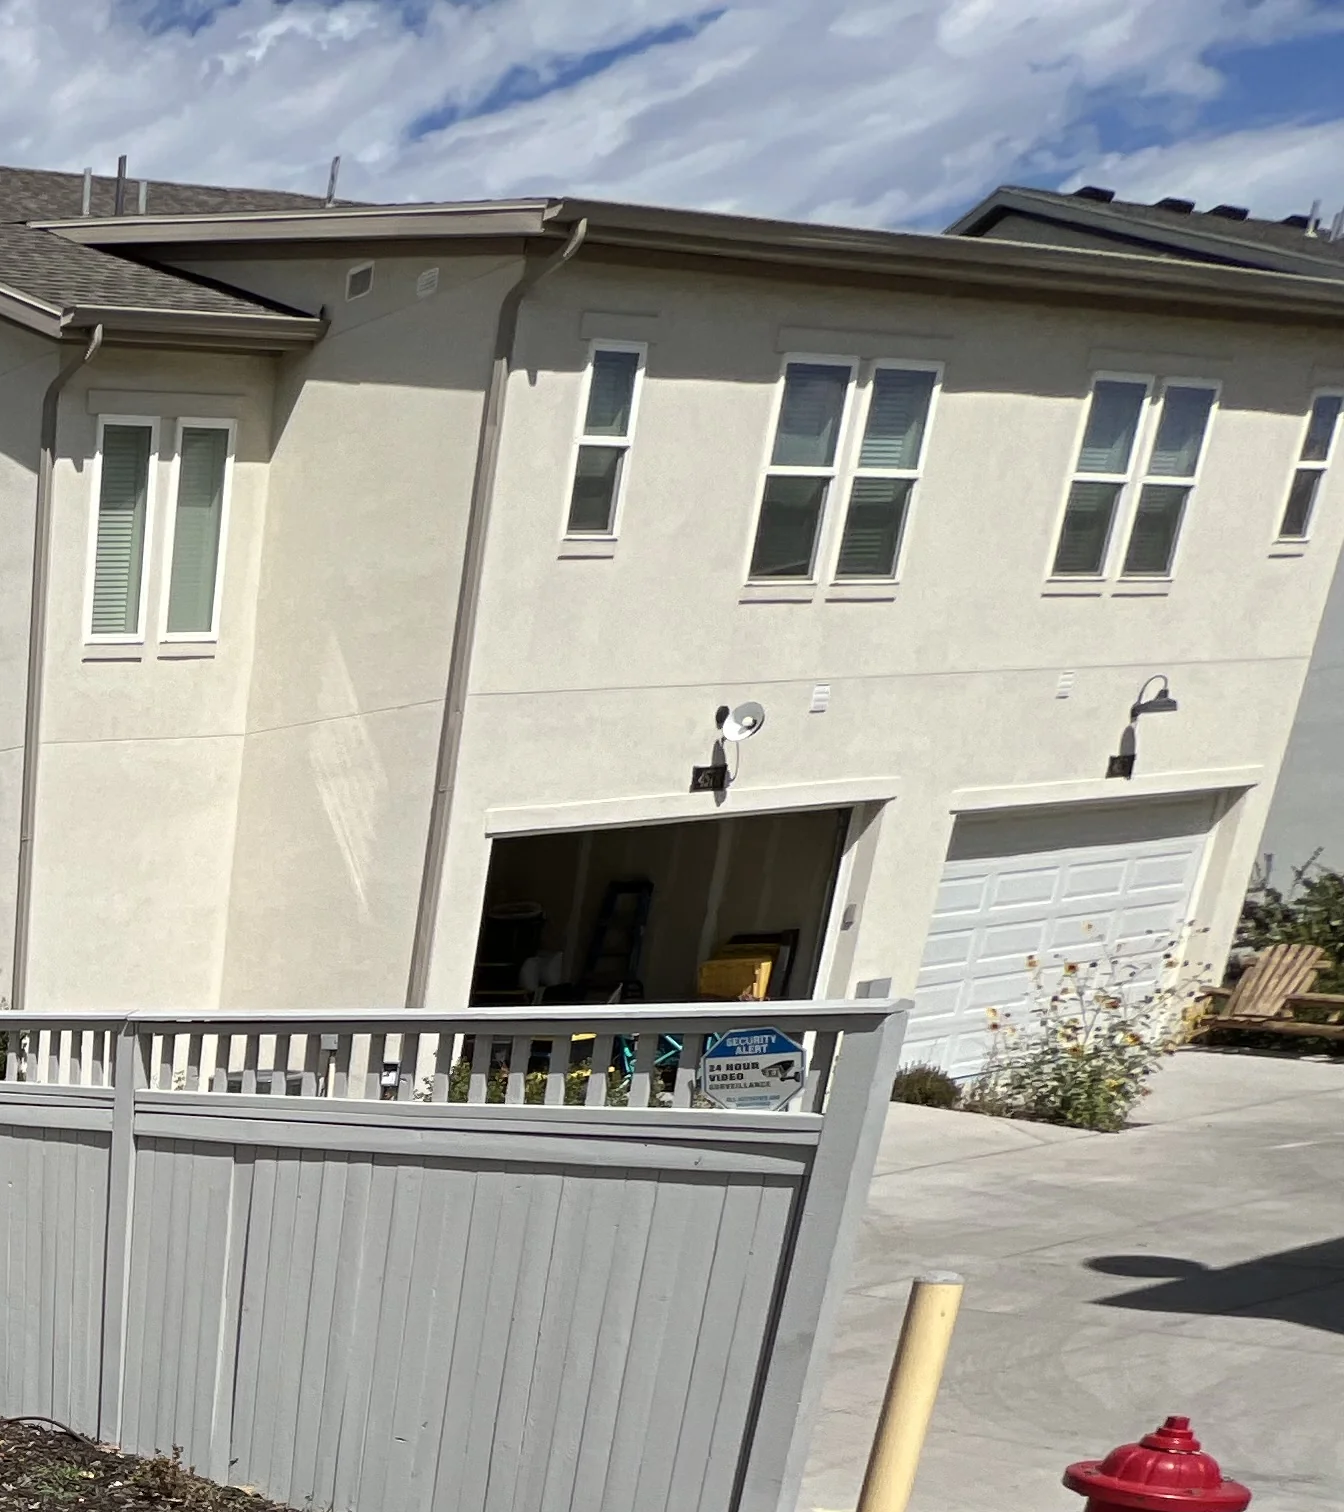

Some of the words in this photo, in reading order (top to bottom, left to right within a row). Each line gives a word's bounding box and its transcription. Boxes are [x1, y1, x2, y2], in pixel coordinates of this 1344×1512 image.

[726, 1035, 776, 1047] SECURITY
[735, 1045, 768, 1055] ALERT
[709, 1064, 722, 1072] 24
[726, 1062, 760, 1071] HOUR
[709, 1073, 744, 1082] VIDEO
